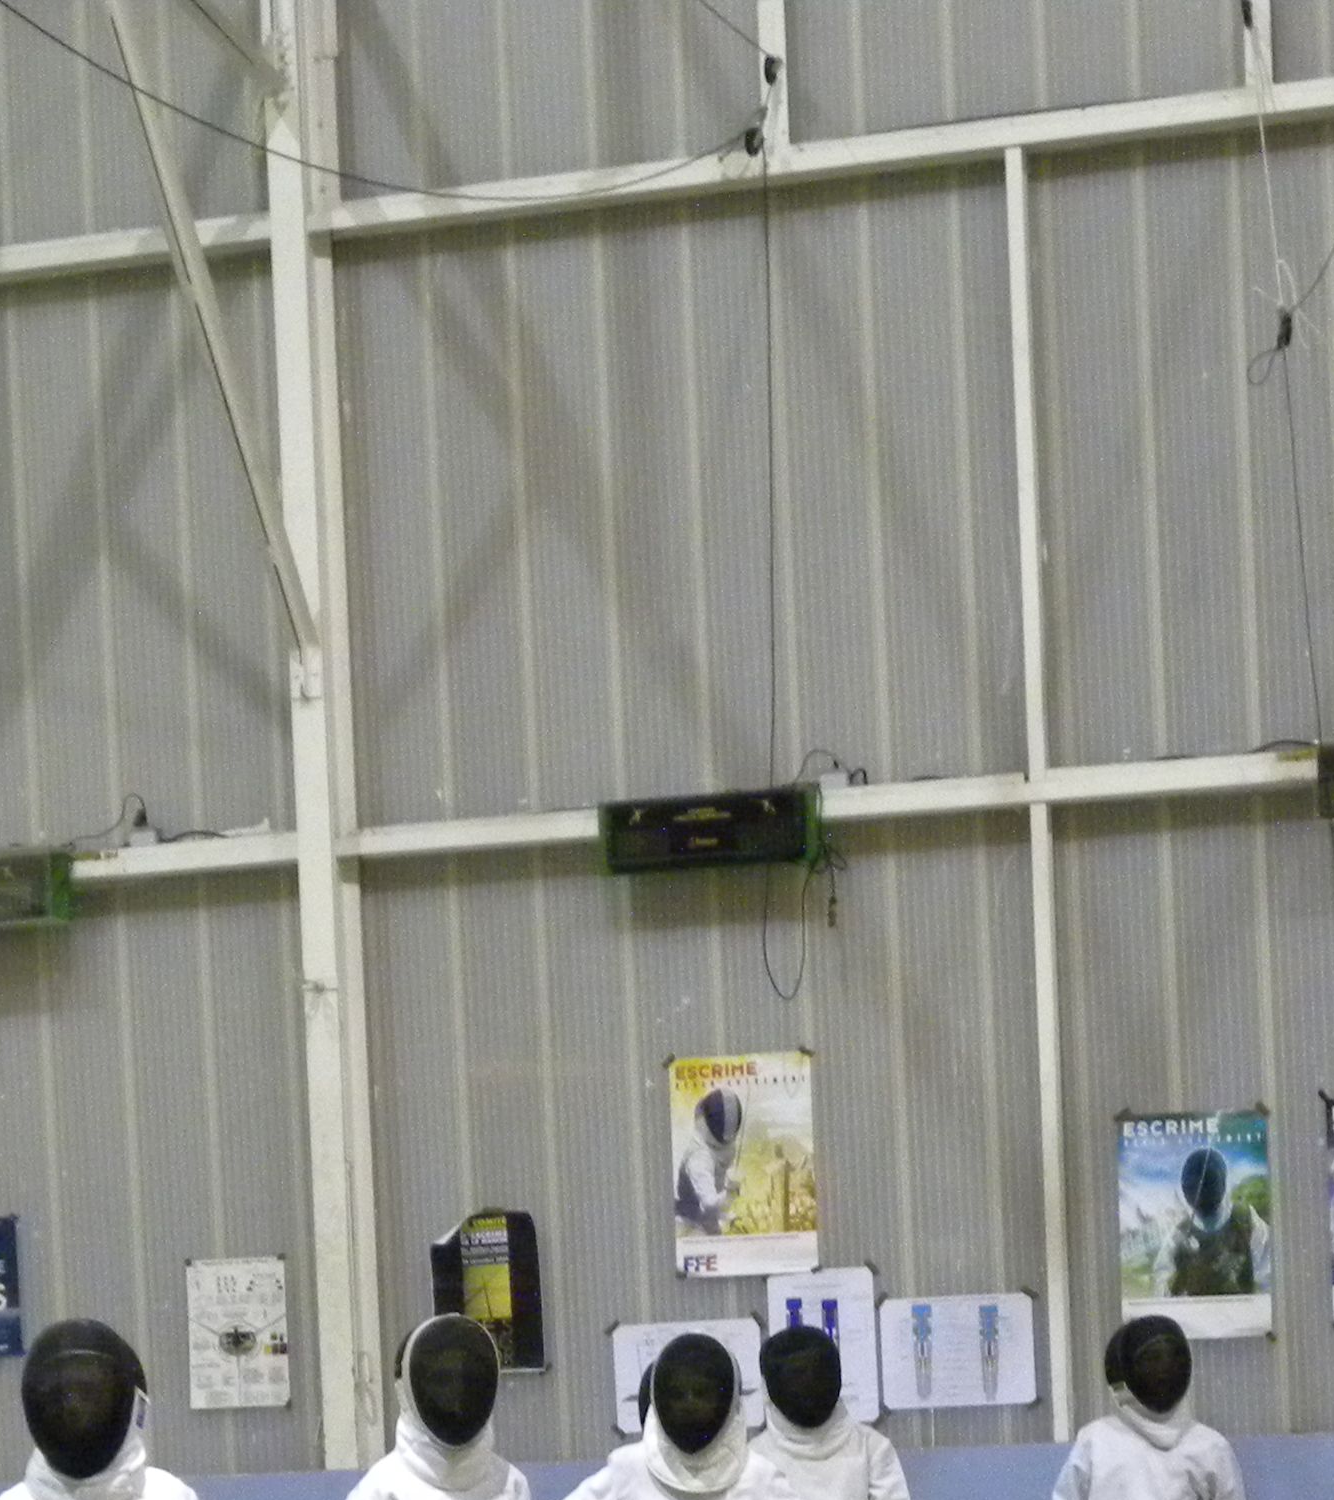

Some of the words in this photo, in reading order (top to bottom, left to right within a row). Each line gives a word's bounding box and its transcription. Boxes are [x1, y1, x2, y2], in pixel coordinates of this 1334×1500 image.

[676, 1061, 757, 1080] ESCRIME
[1123, 1117, 1219, 1137] ESCRIME
[684, 1254, 717, 1272] FFE
